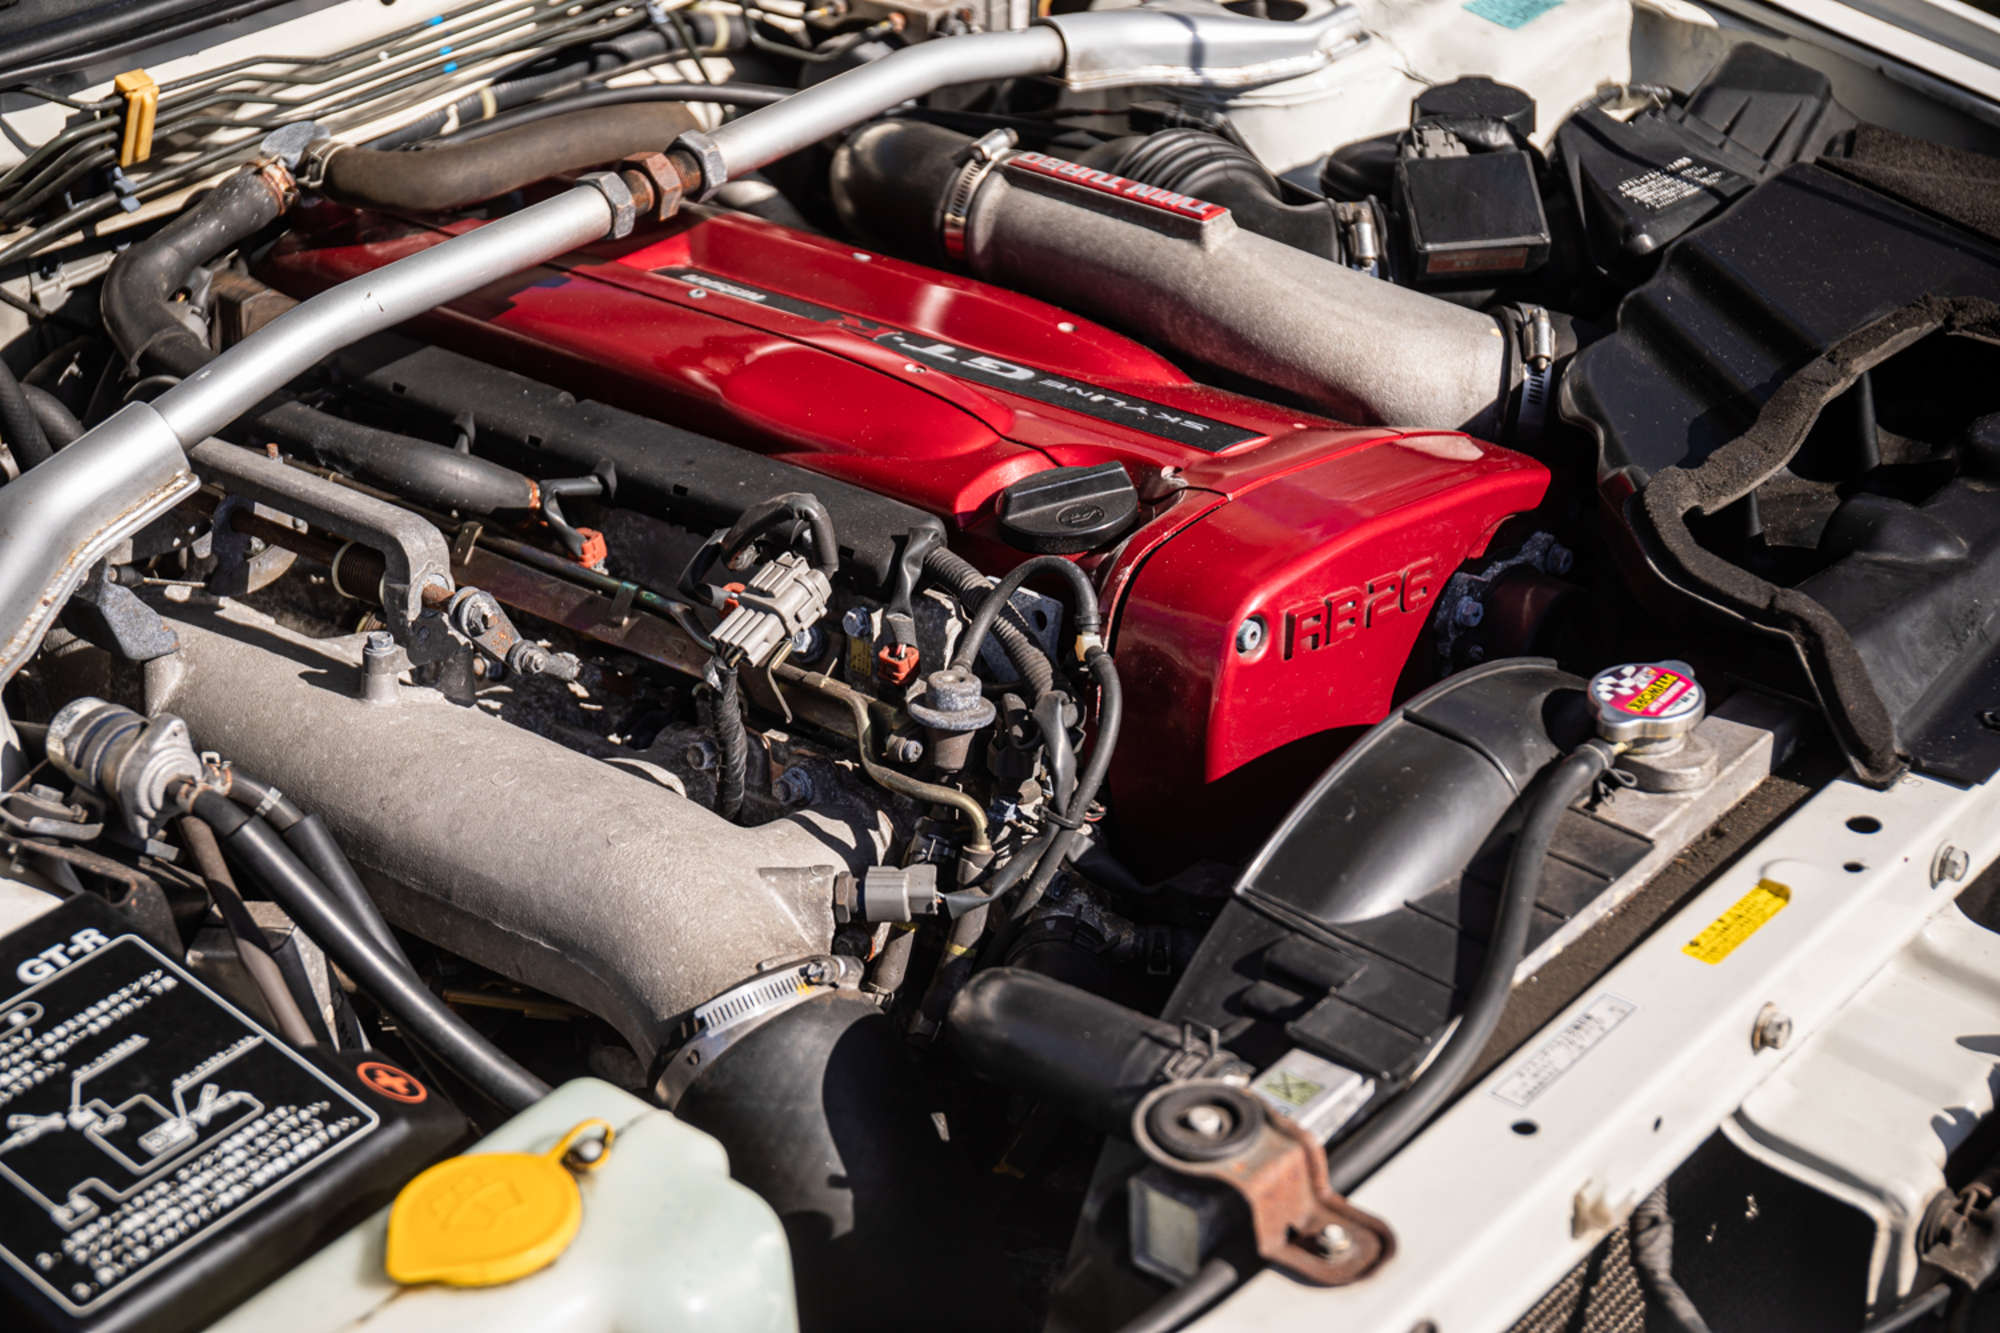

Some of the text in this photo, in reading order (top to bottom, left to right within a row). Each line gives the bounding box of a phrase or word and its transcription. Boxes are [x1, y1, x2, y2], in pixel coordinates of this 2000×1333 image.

[1018, 152, 1217, 215] TWIN TURBO
[1039, 379, 1210, 431] SKYLINE
[1283, 556, 1434, 661] RB26
[16, 928, 110, 985] GT-R
